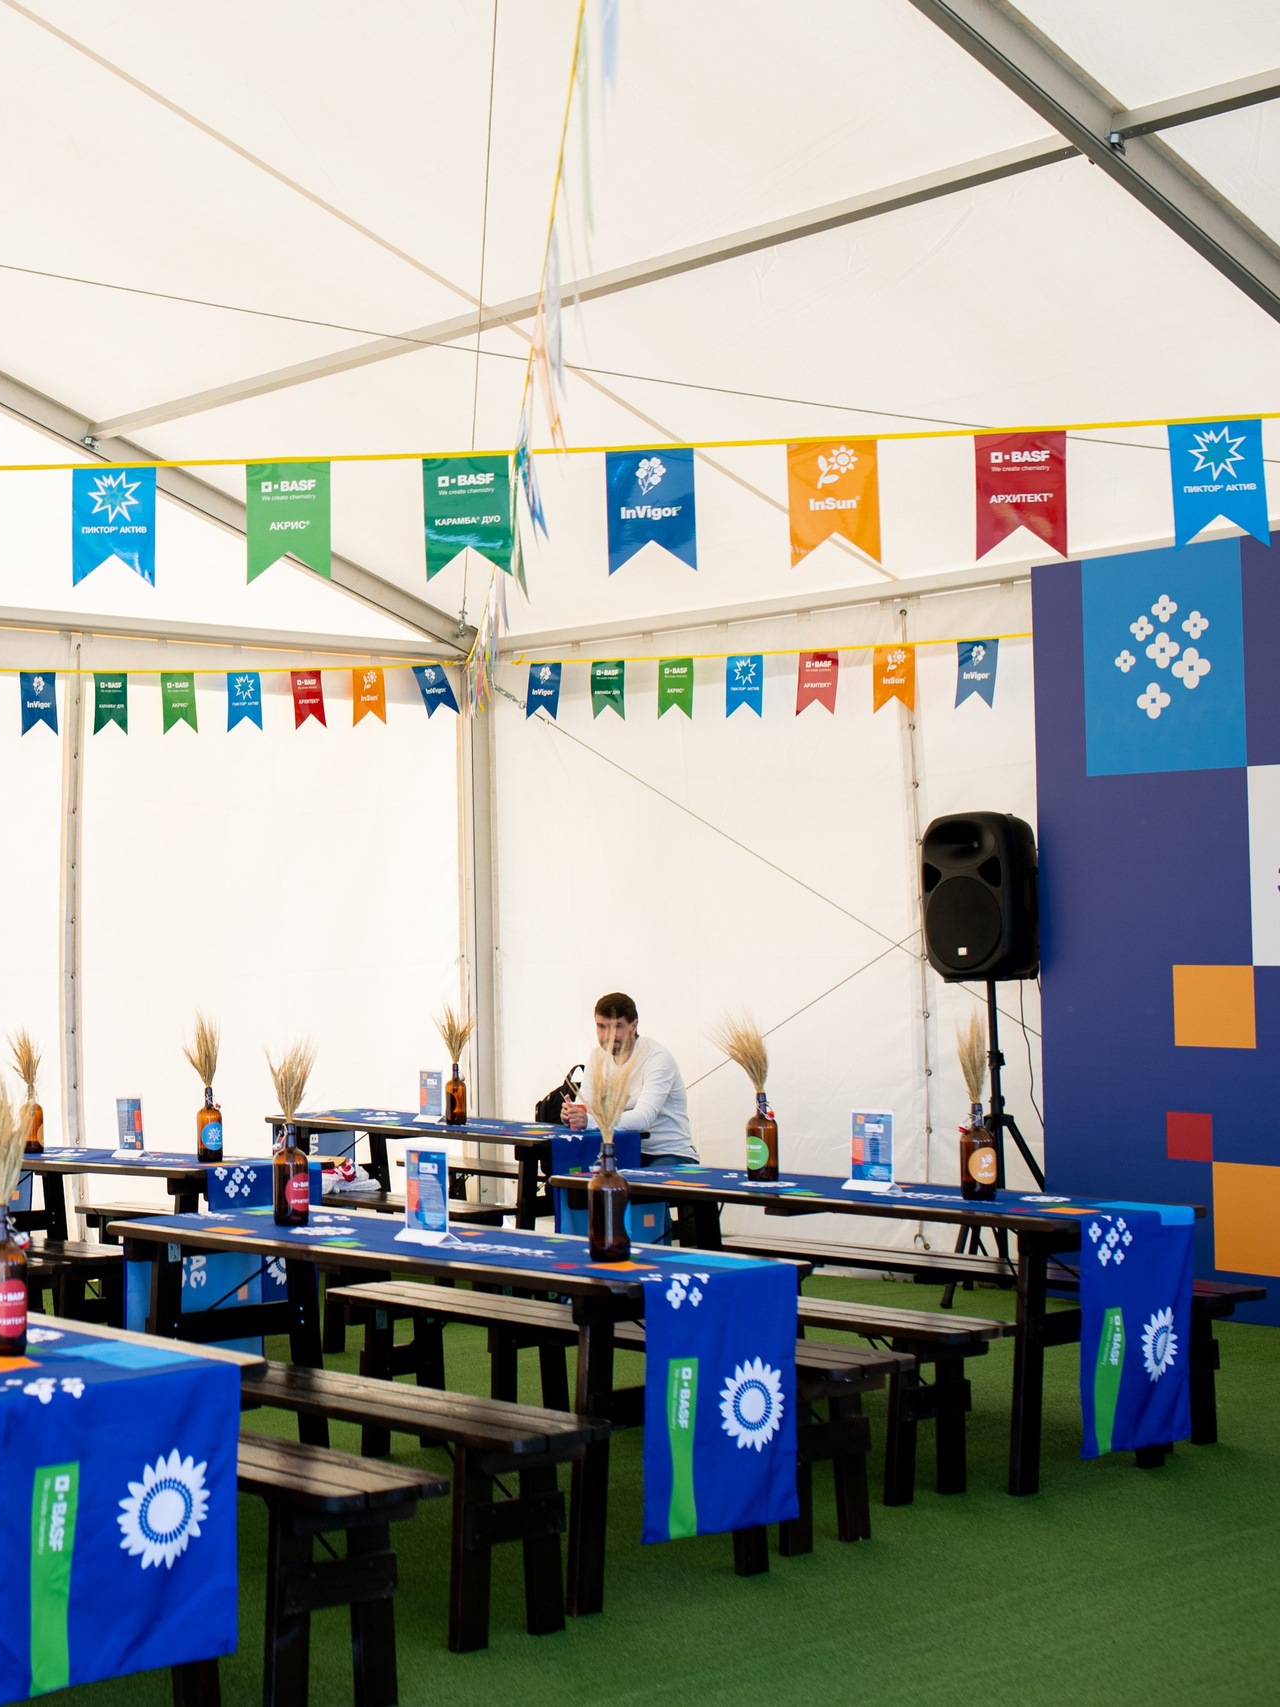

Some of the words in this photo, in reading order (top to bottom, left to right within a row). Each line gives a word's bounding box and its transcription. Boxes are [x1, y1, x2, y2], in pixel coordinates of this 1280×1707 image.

[1011, 450, 1050, 462] BASF
[280, 479, 317, 492] BASF
[457, 473, 495, 486] BASF
[1225, 483, 1257, 491] АКТИВ
[621, 506, 682, 520] InVigor
[481, 515, 501, 525] ДУО
[119, 526, 147, 534] АКТИВ
[963, 671, 990, 681] InVigor
[1109, 1333, 1121, 1366] BASF
[678, 1388, 691, 1429] BASF
[49, 1501, 68, 1552] BASF
